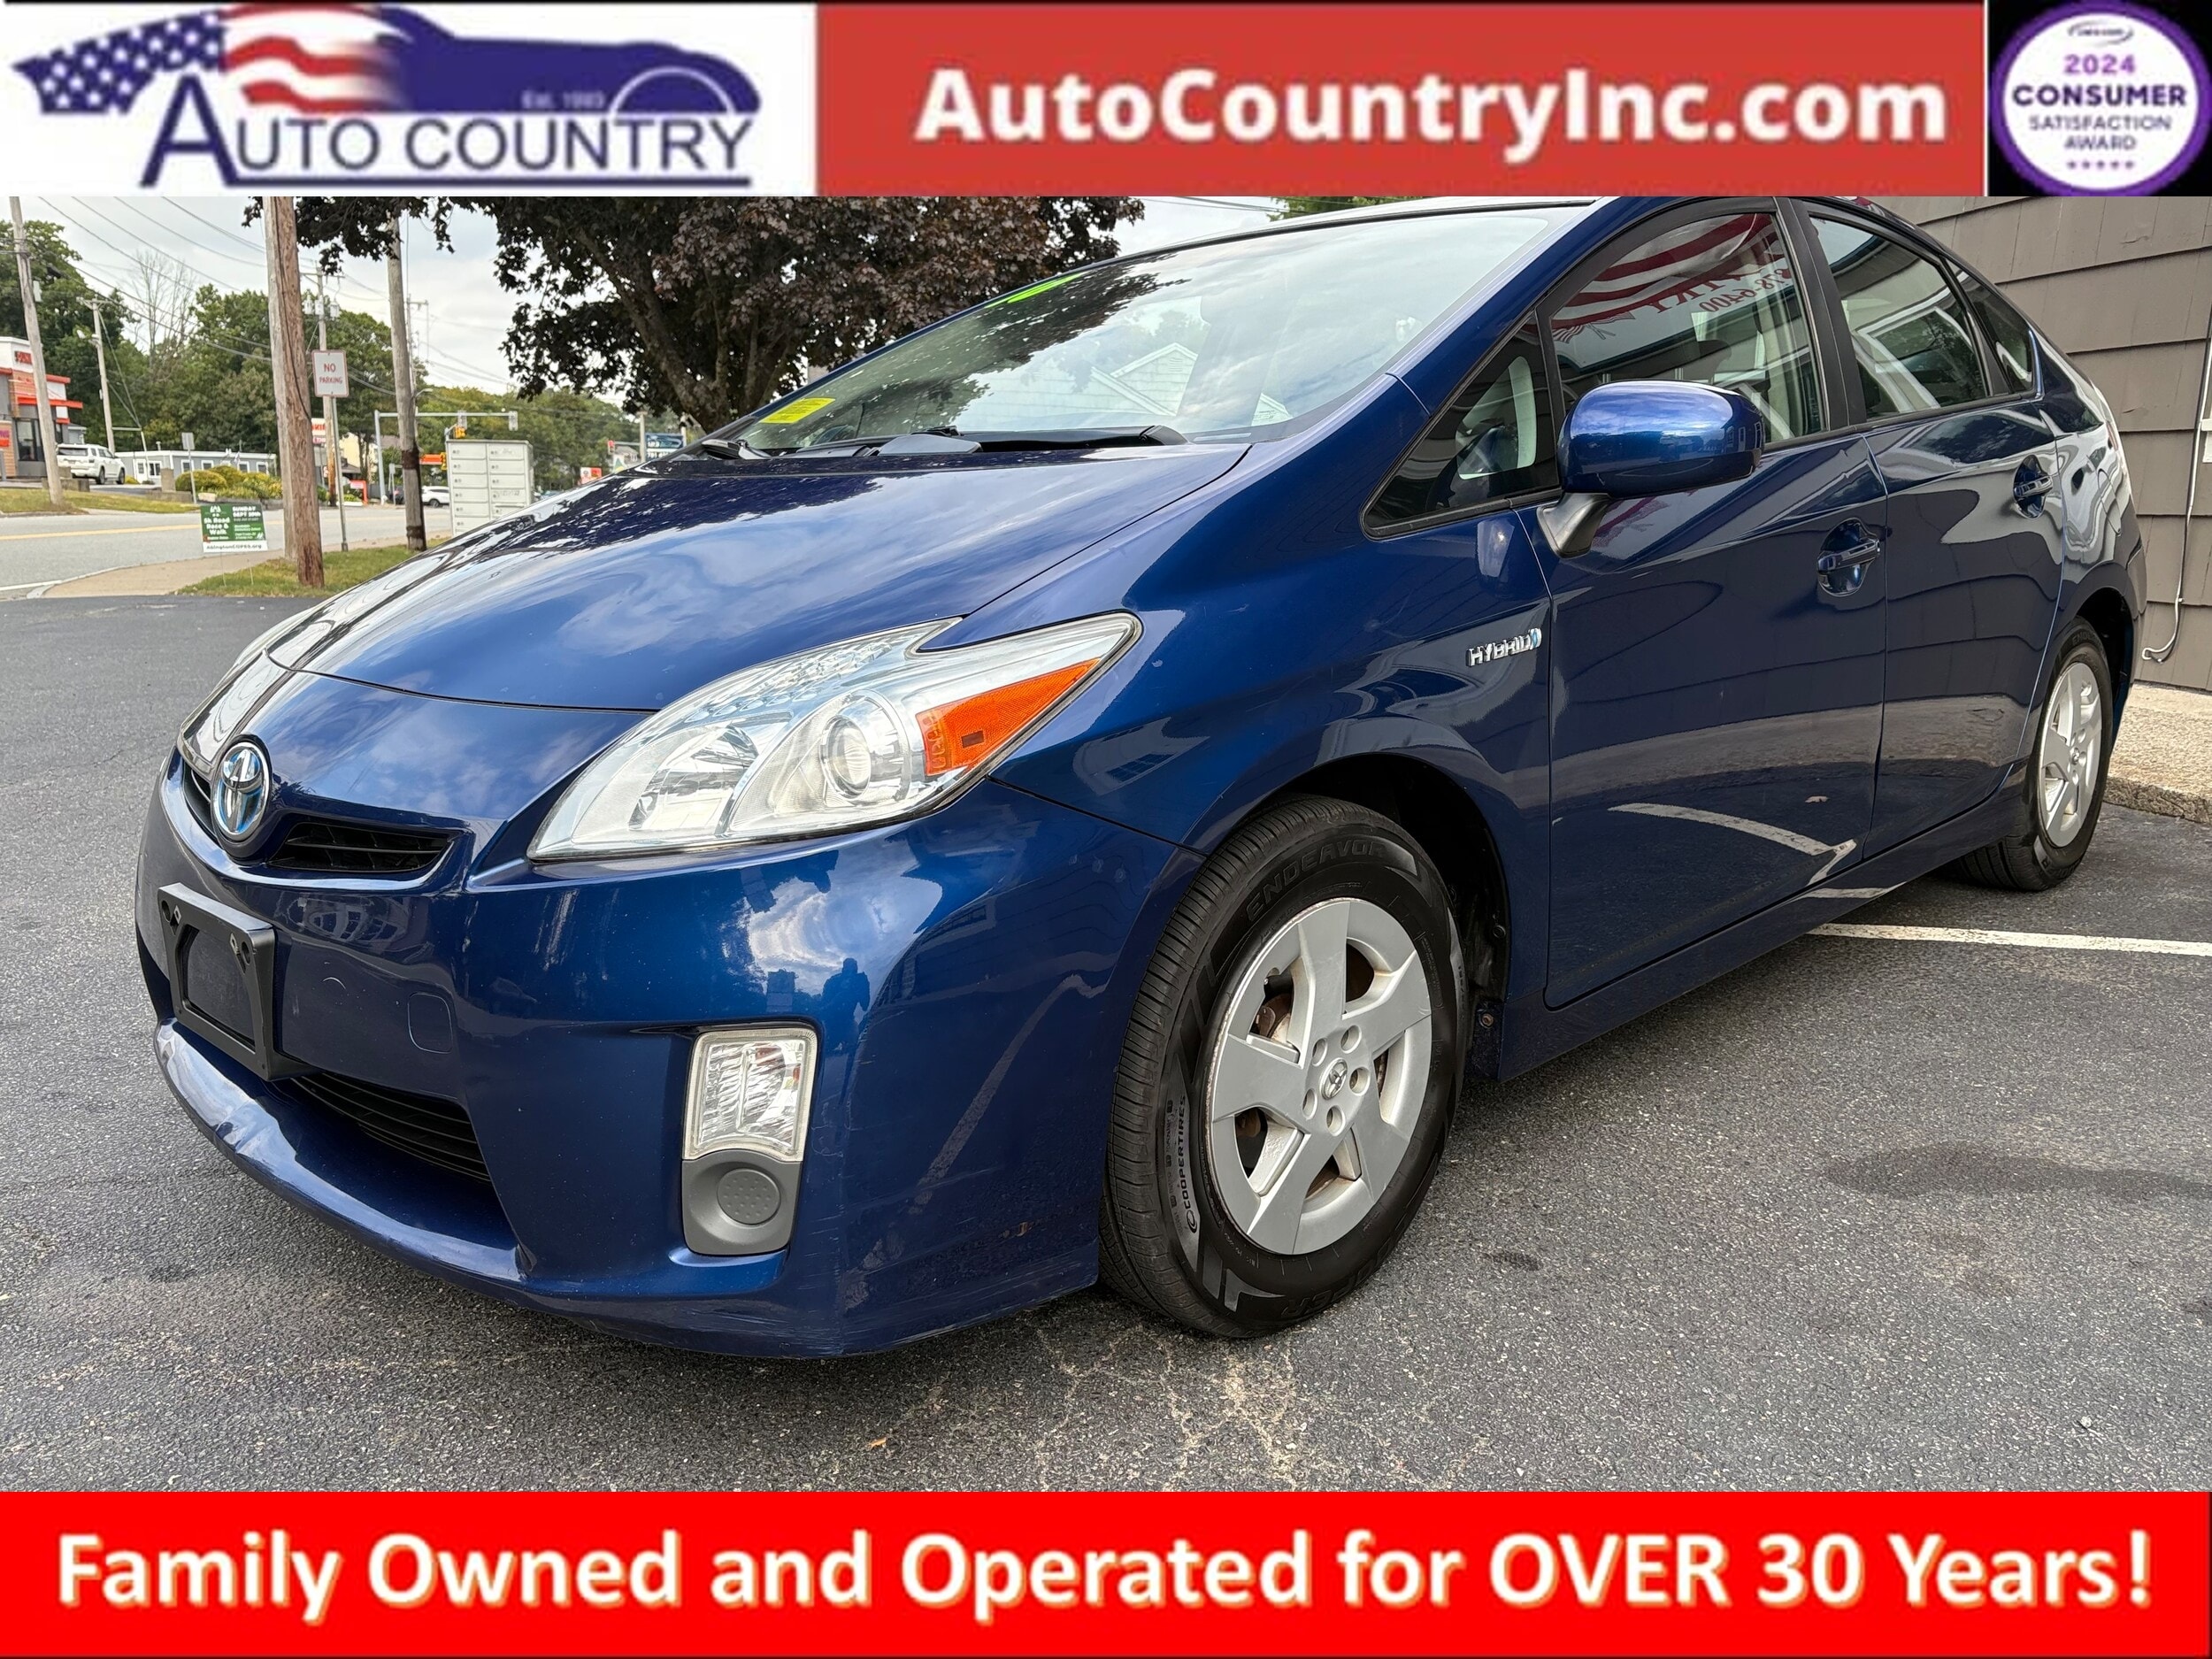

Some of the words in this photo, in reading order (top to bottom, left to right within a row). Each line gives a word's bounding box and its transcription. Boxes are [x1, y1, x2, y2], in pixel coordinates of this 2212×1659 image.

[323, 363, 336, 373] NO
[1467, 633, 1532, 667] HYBRID
[1245, 840, 1387, 922] ENDEAVOR
